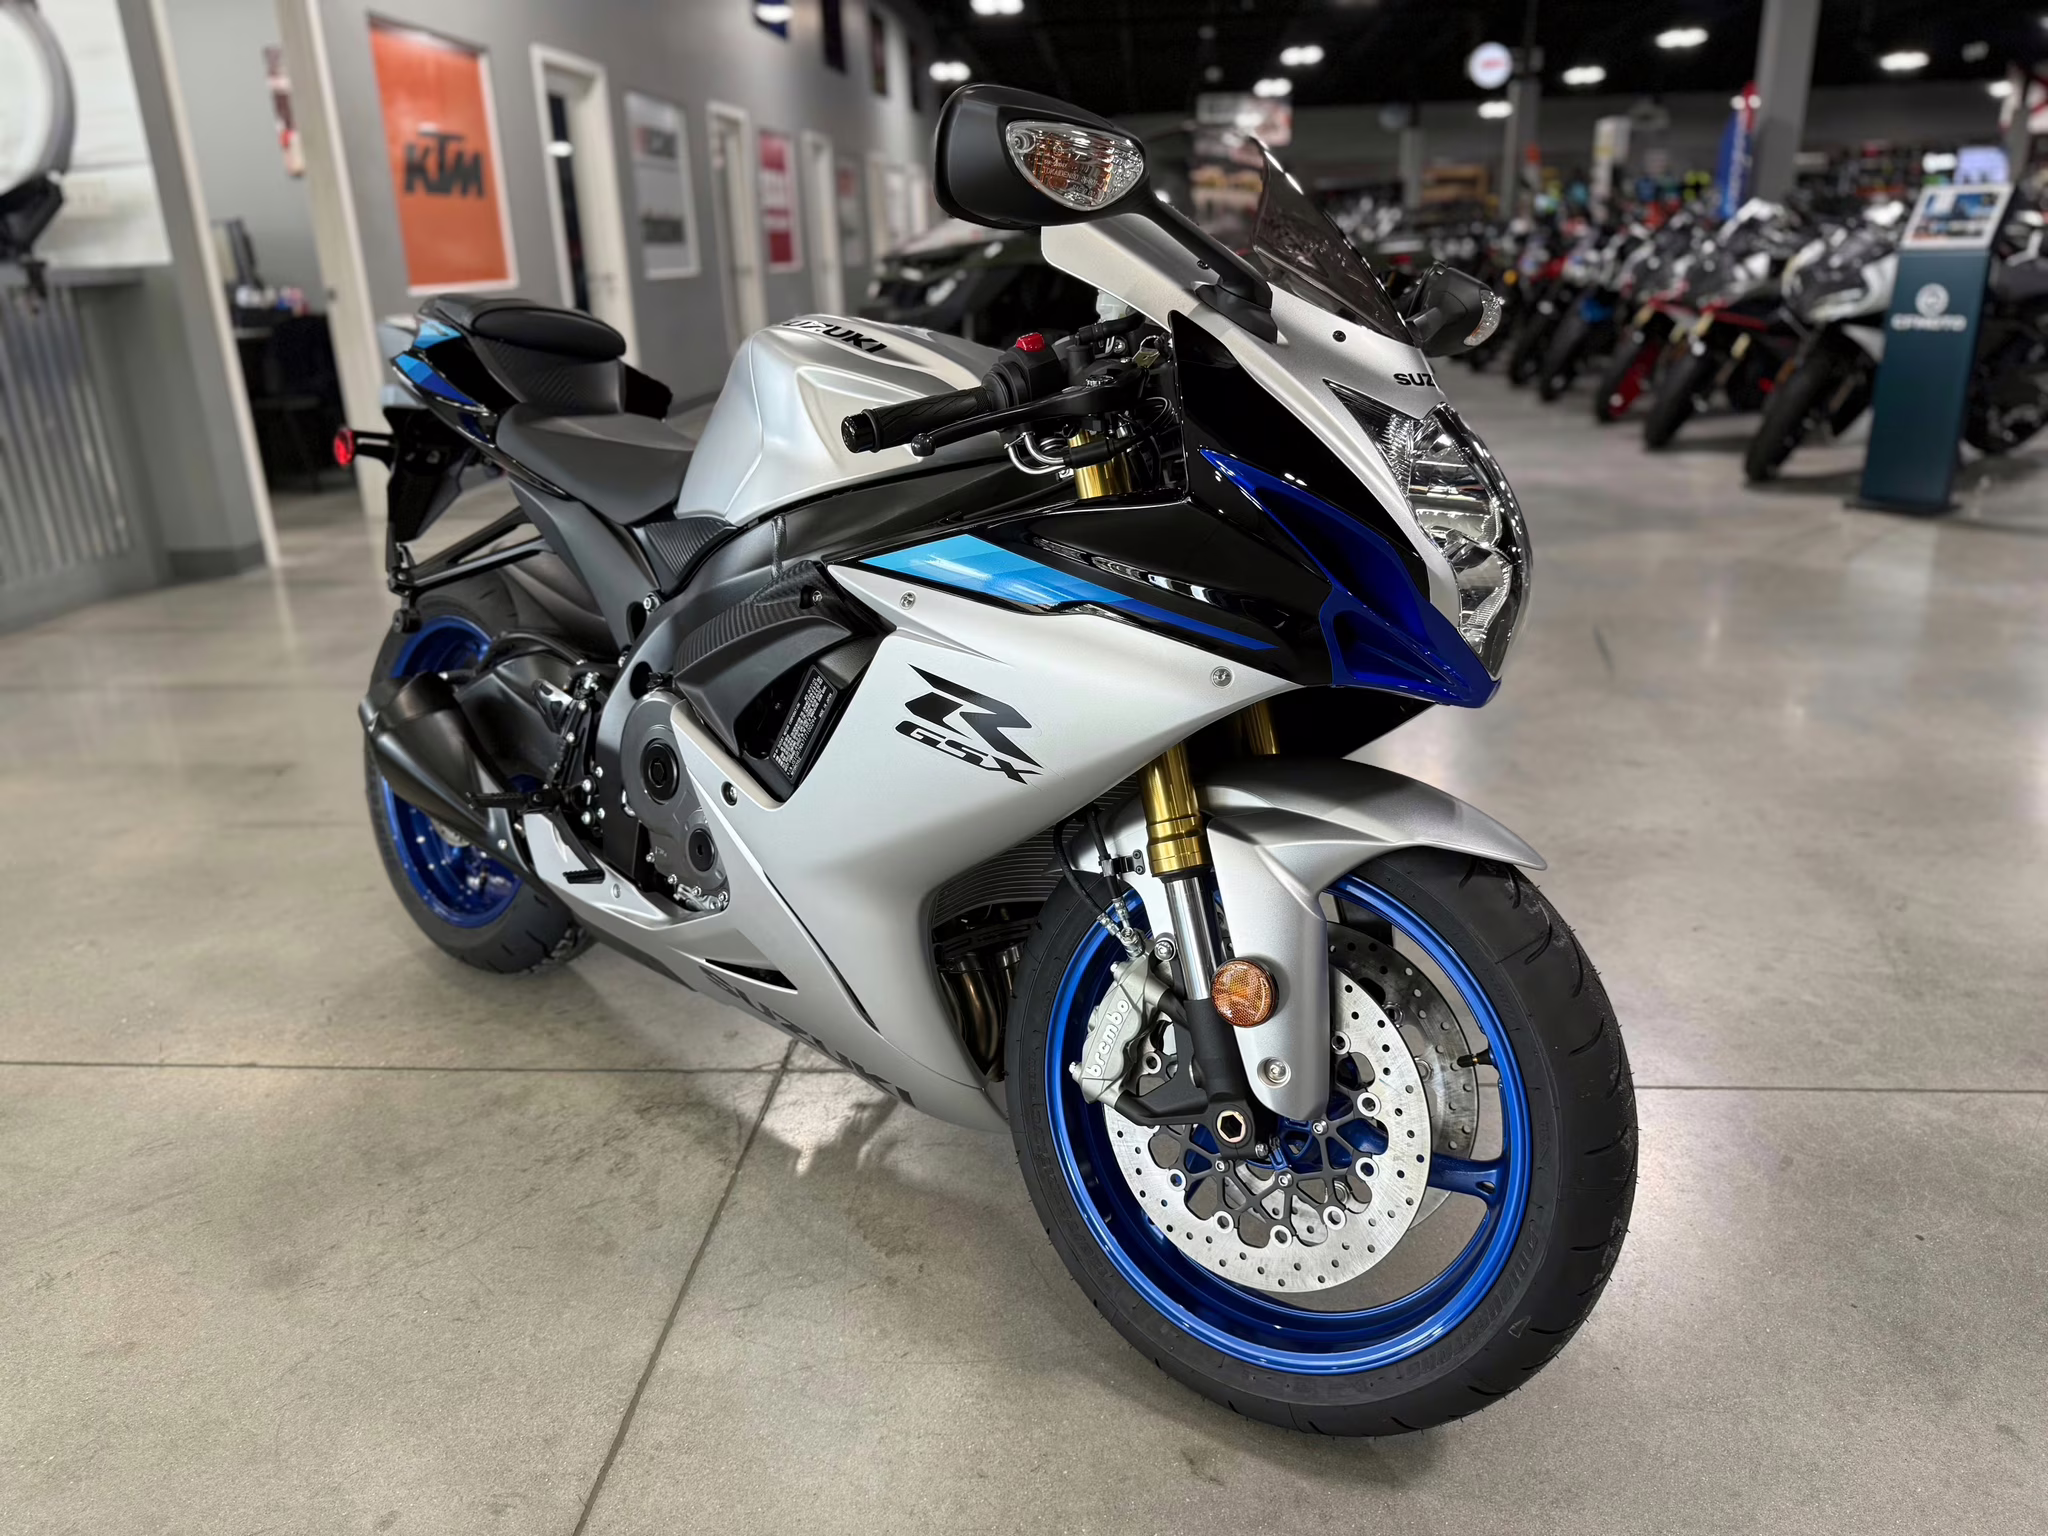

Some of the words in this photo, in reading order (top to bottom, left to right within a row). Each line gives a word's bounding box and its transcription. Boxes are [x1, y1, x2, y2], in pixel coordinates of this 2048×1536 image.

[404, 132, 484, 199] KTM
[781, 320, 888, 353] UZUKI
[904, 663, 1044, 769] R
[895, 720, 1044, 785] GSX
[699, 965, 916, 1109] SUZUKI
[1085, 1000, 1130, 1077] brembo
